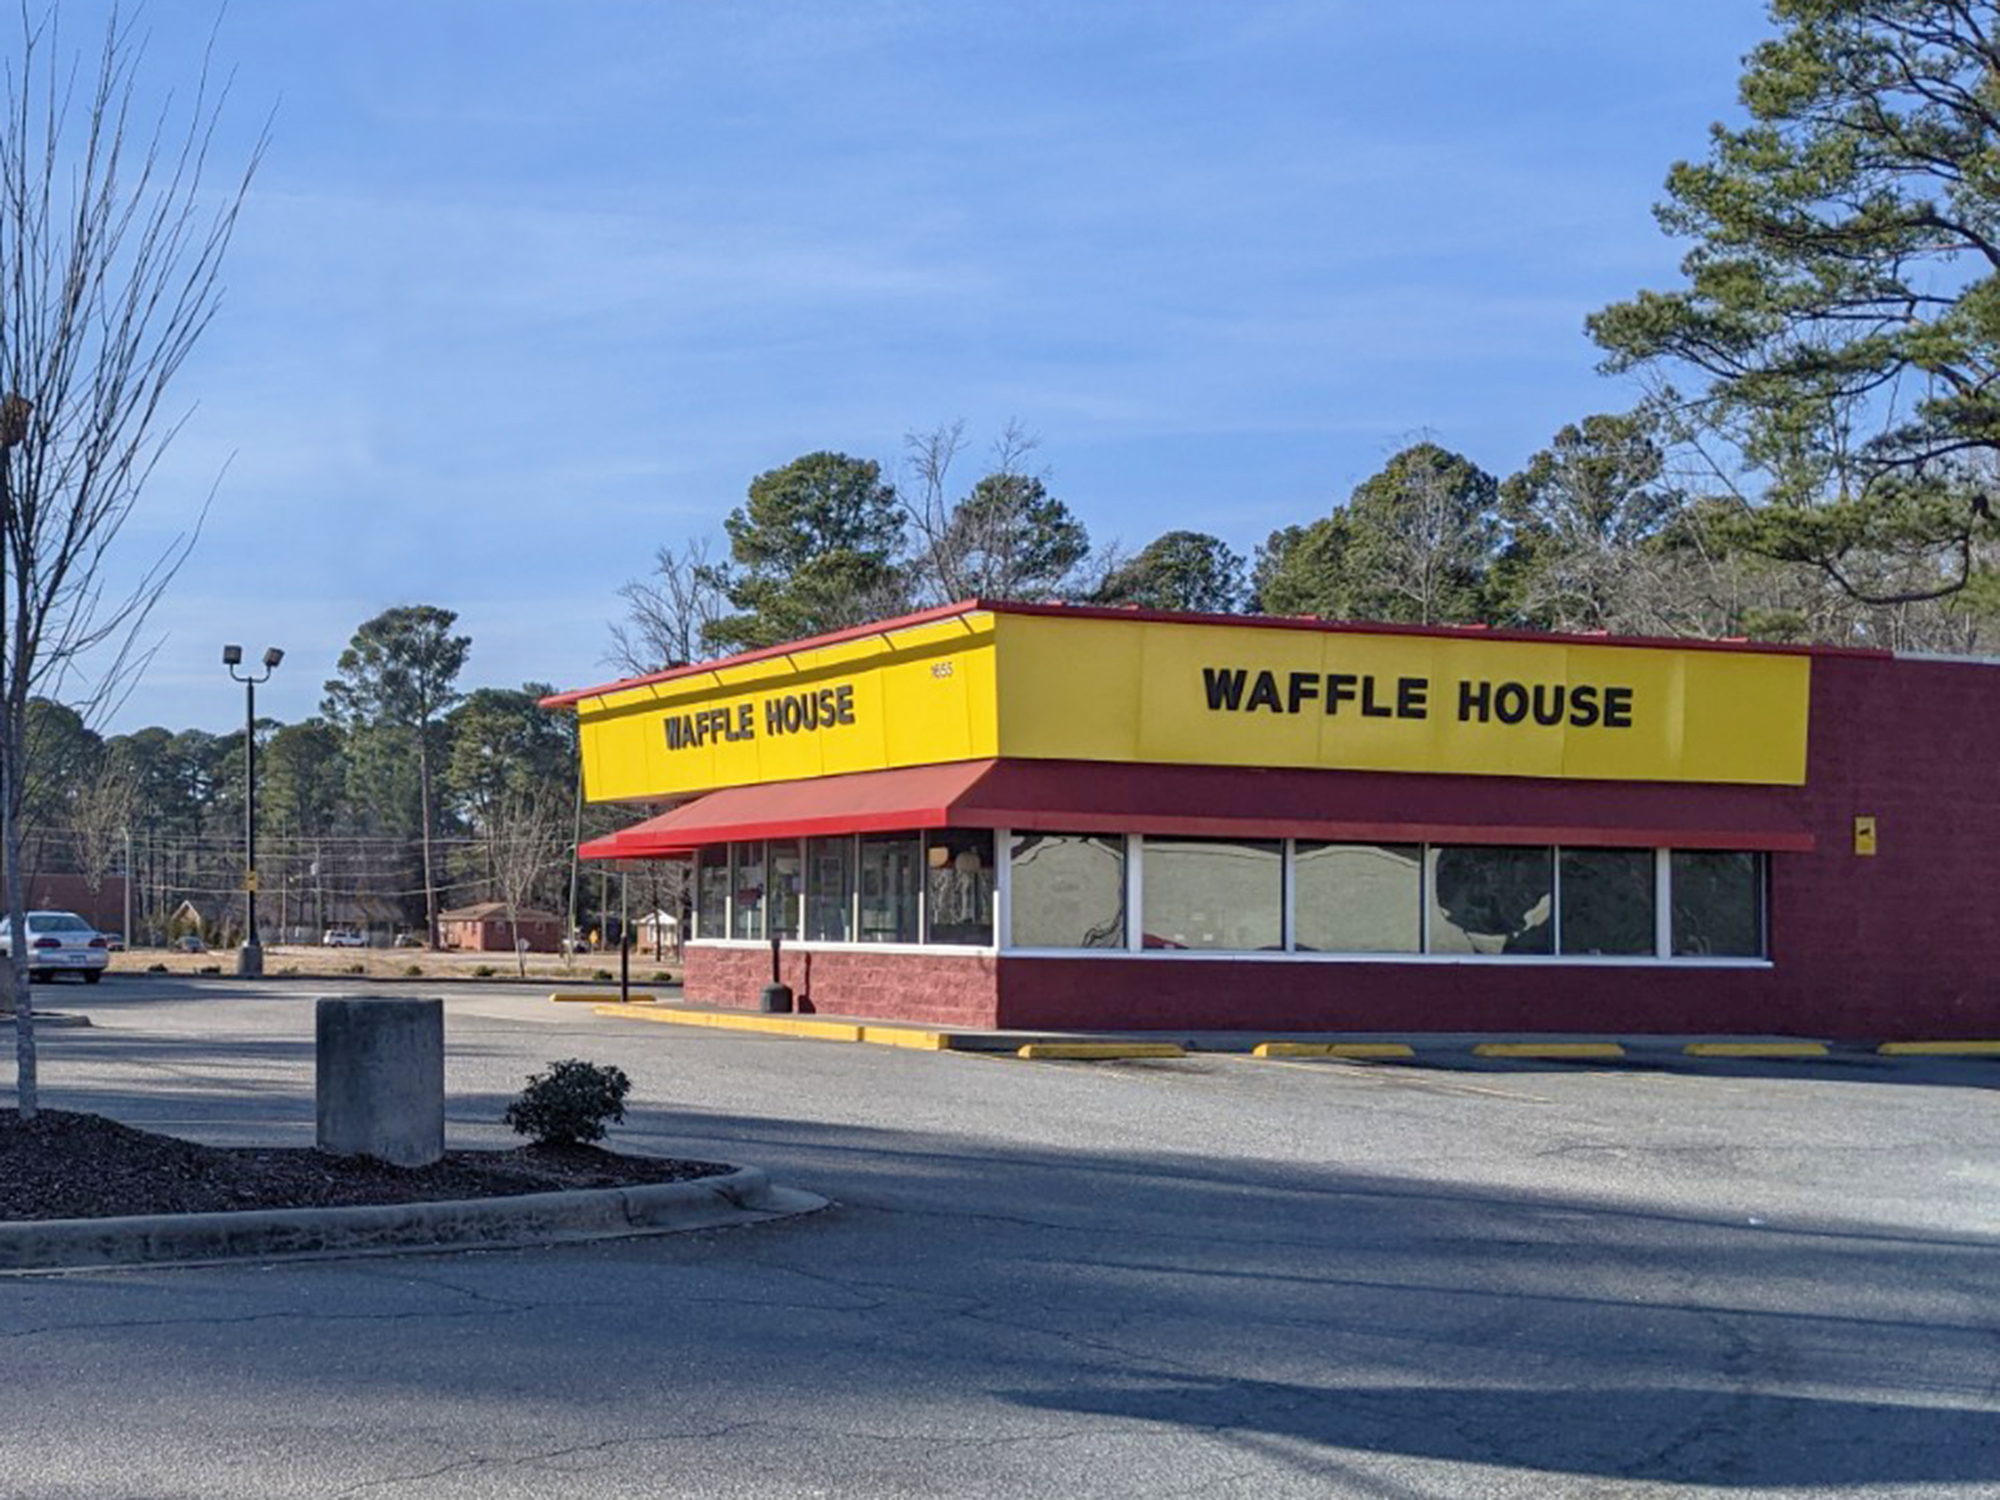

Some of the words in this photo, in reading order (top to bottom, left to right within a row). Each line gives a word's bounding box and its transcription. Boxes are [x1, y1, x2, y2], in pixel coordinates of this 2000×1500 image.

[664, 703, 754, 750] WAFFLE
[765, 685, 855, 736] HOUSE
[1203, 668, 1429, 719] WAFFLE
[1458, 680, 1633, 728] HOUSE
